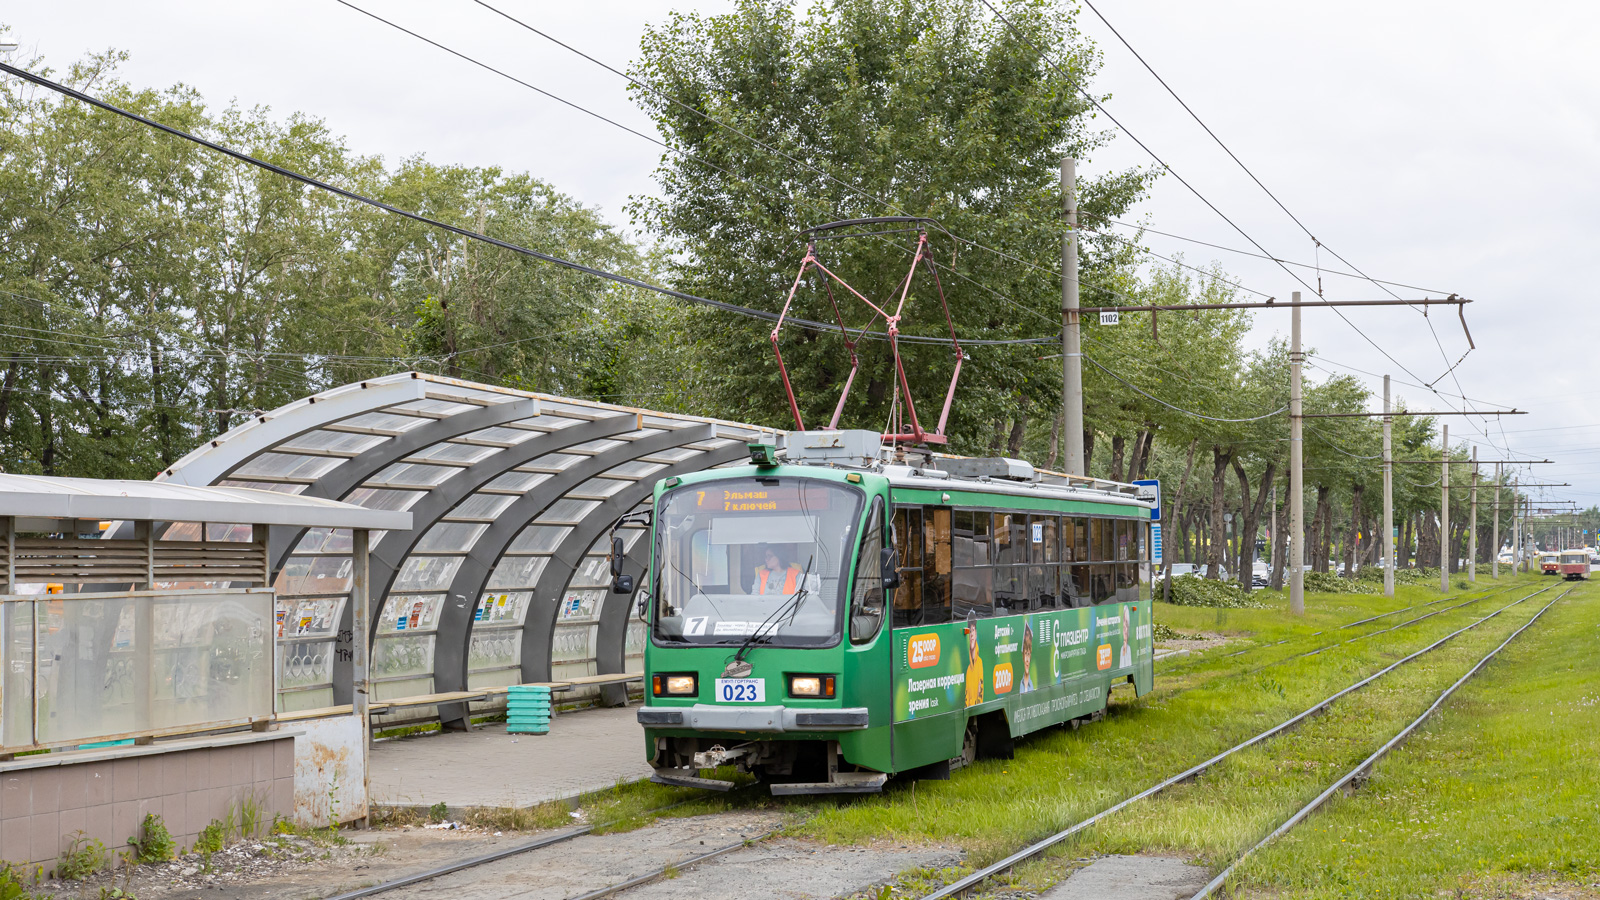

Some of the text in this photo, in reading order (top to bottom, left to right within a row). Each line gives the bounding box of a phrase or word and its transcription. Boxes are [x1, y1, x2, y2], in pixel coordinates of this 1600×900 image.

[1101, 314, 1118, 323] 1102
[696, 491, 706, 506] 7
[723, 490, 768, 500] Эльмаш
[724, 501, 777, 511] 7 ключей
[691, 617, 705, 634] 7
[908, 673, 965, 694] Лазерная коррекция
[723, 684, 757, 701] 023
[908, 698, 930, 715] зрения
